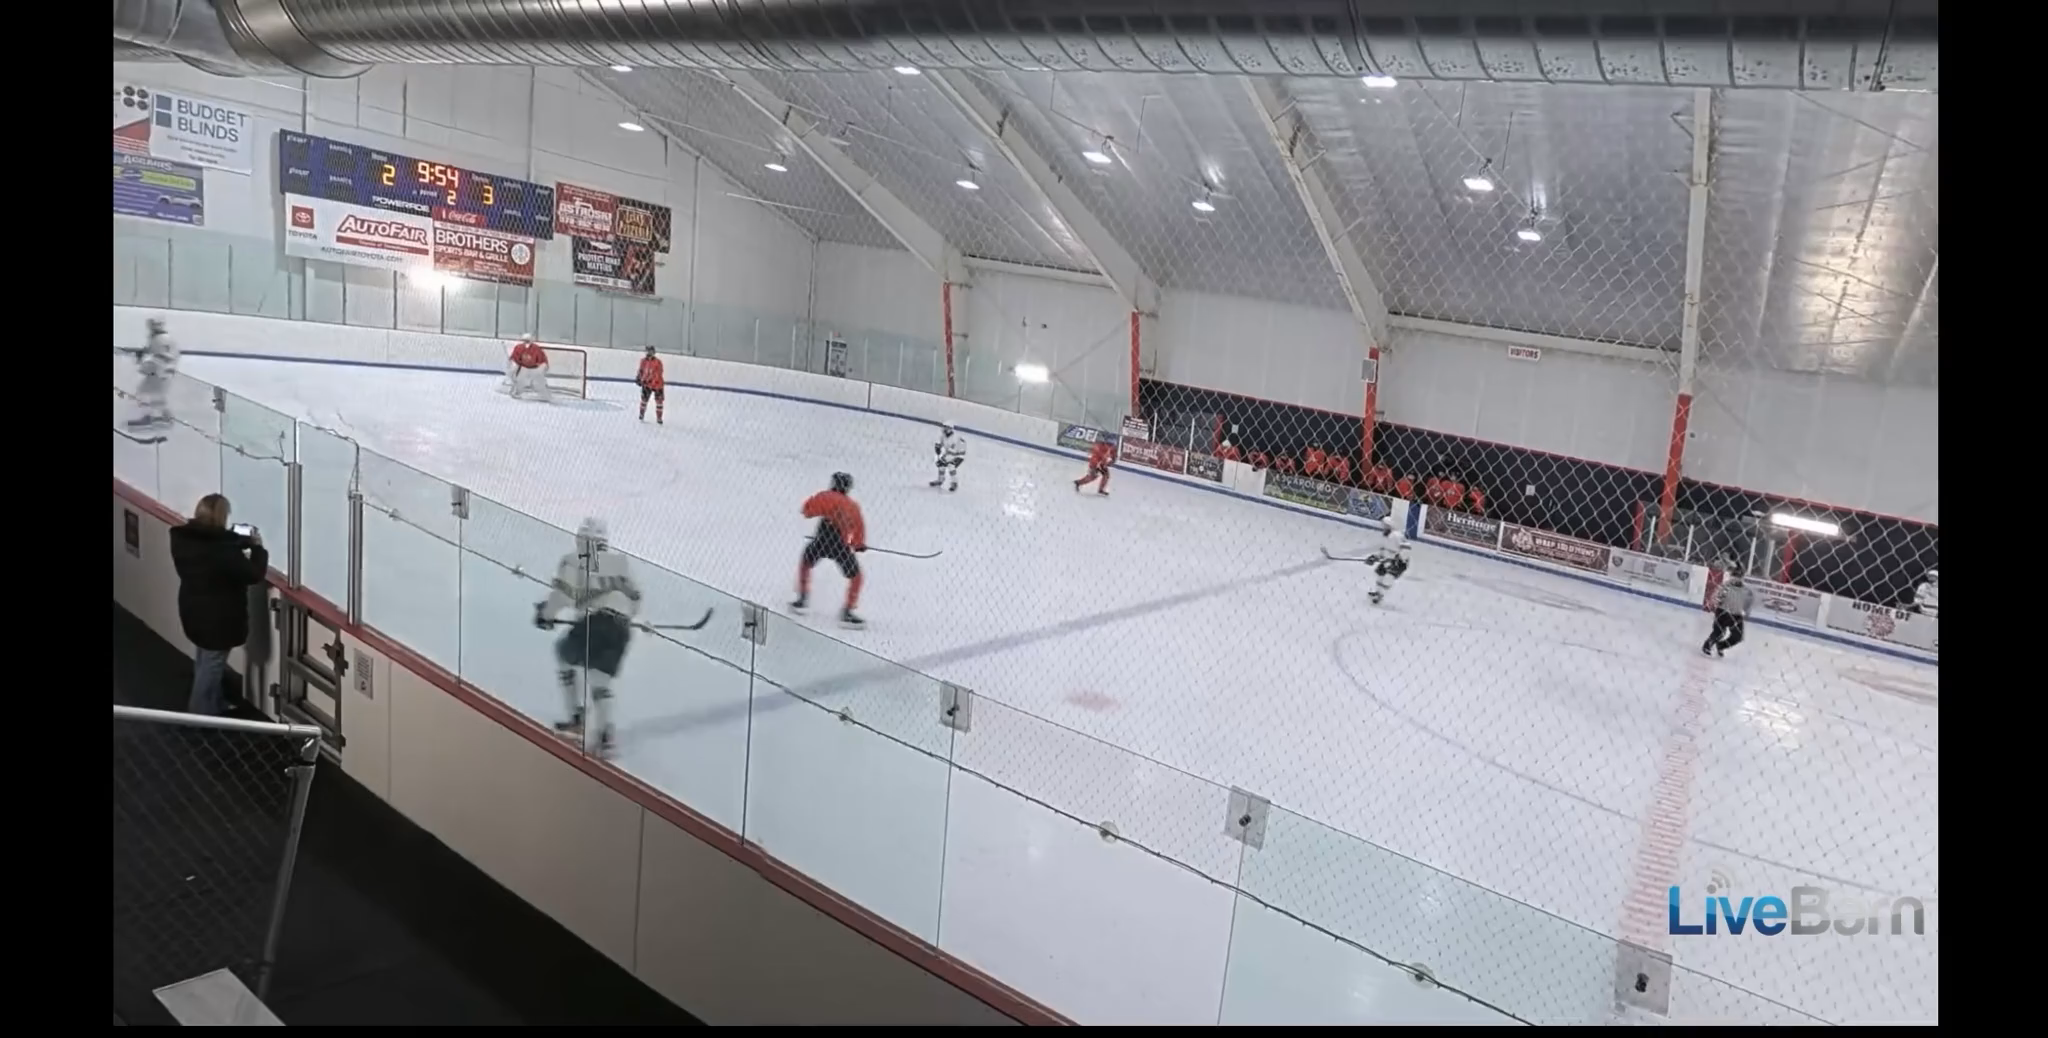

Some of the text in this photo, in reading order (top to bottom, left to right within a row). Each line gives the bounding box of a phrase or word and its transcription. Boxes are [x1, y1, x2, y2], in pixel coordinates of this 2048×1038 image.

[177, 99, 247, 128] BUDGET
[177, 116, 239, 143] BLINDS
[382, 164, 395, 186] 2
[417, 162, 459, 188] 9:54
[447, 189, 457, 206] 2
[483, 185, 494, 205] 3
[288, 229, 318, 240] TOYOTA
[435, 229, 509, 254] BROTHERS
[435, 244, 462, 256] SPORTS
[463, 248, 478, 258] BAR
[485, 251, 508, 262] GRILLE
[1447, 512, 1497, 532] Heritage
[1851, 601, 1913, 622] HOME OF
